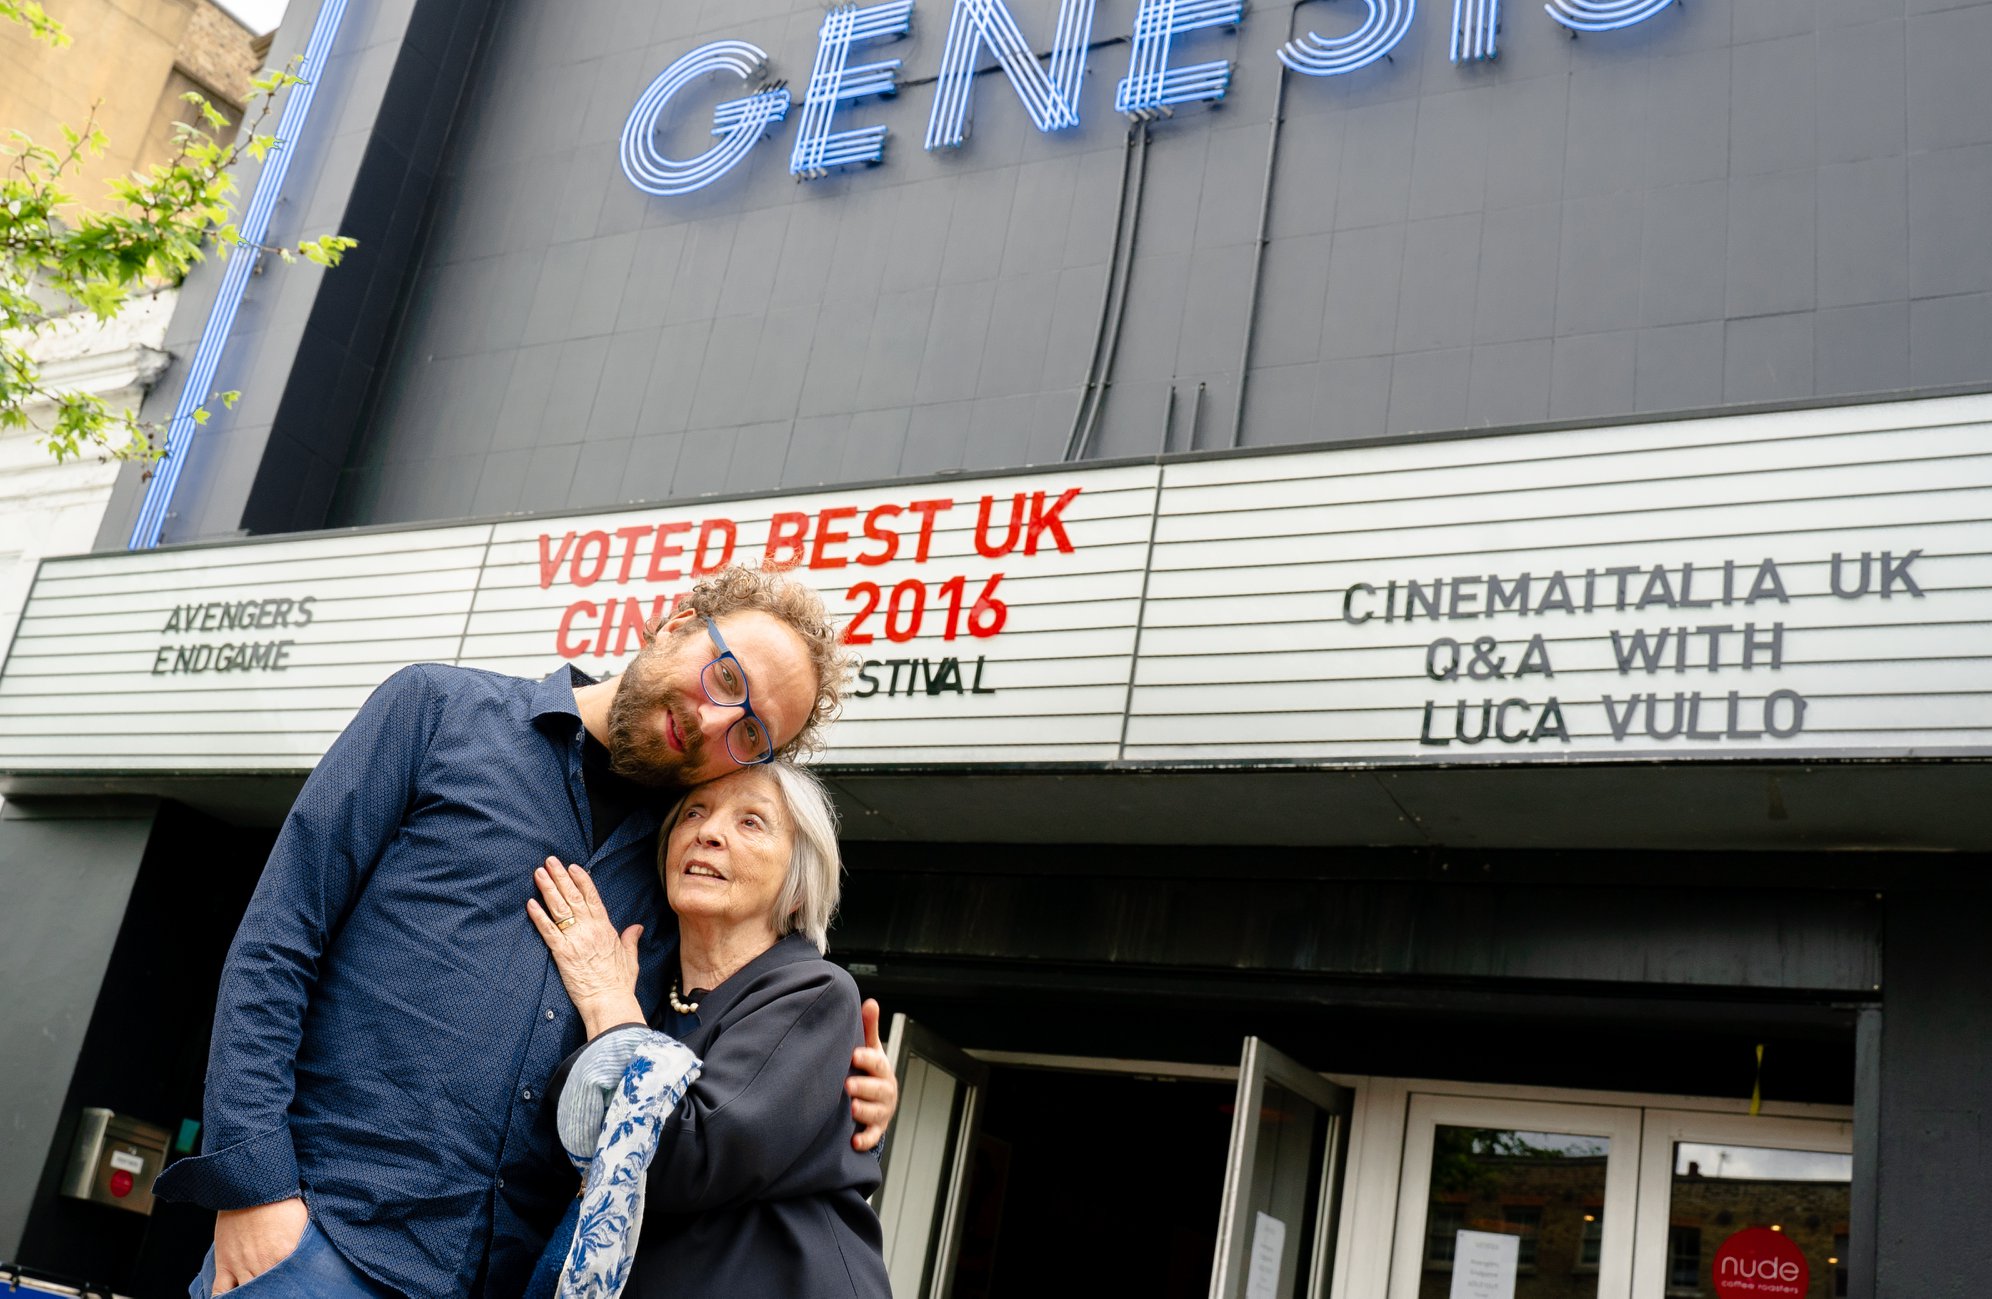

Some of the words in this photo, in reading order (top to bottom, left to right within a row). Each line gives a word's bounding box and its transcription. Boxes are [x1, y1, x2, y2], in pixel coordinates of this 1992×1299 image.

[538, 517, 737, 590] VOTED
[761, 499, 953, 572] BEST
[974, 486, 1082, 559] UK
[1342, 557, 1790, 624] CINEMAITALIA
[1829, 549, 1925, 600] UK
[162, 596, 317, 634] AVENGERS
[556, 592, 694, 659] CIN
[837, 573, 1007, 645] 2016
[151, 640, 295, 675] ENDGAME
[848, 654, 996, 698] STIVAL
[1425, 633, 1554, 682] Q&A
[1610, 622, 1784, 675] WITH
[1419, 697, 1570, 746] LUCA
[1602, 689, 1808, 741] VULLO
[1721, 1256, 1799, 1282] nude
[1721, 1280, 1755, 1290] coffee
[1757, 1284, 1798, 1294] roasters
